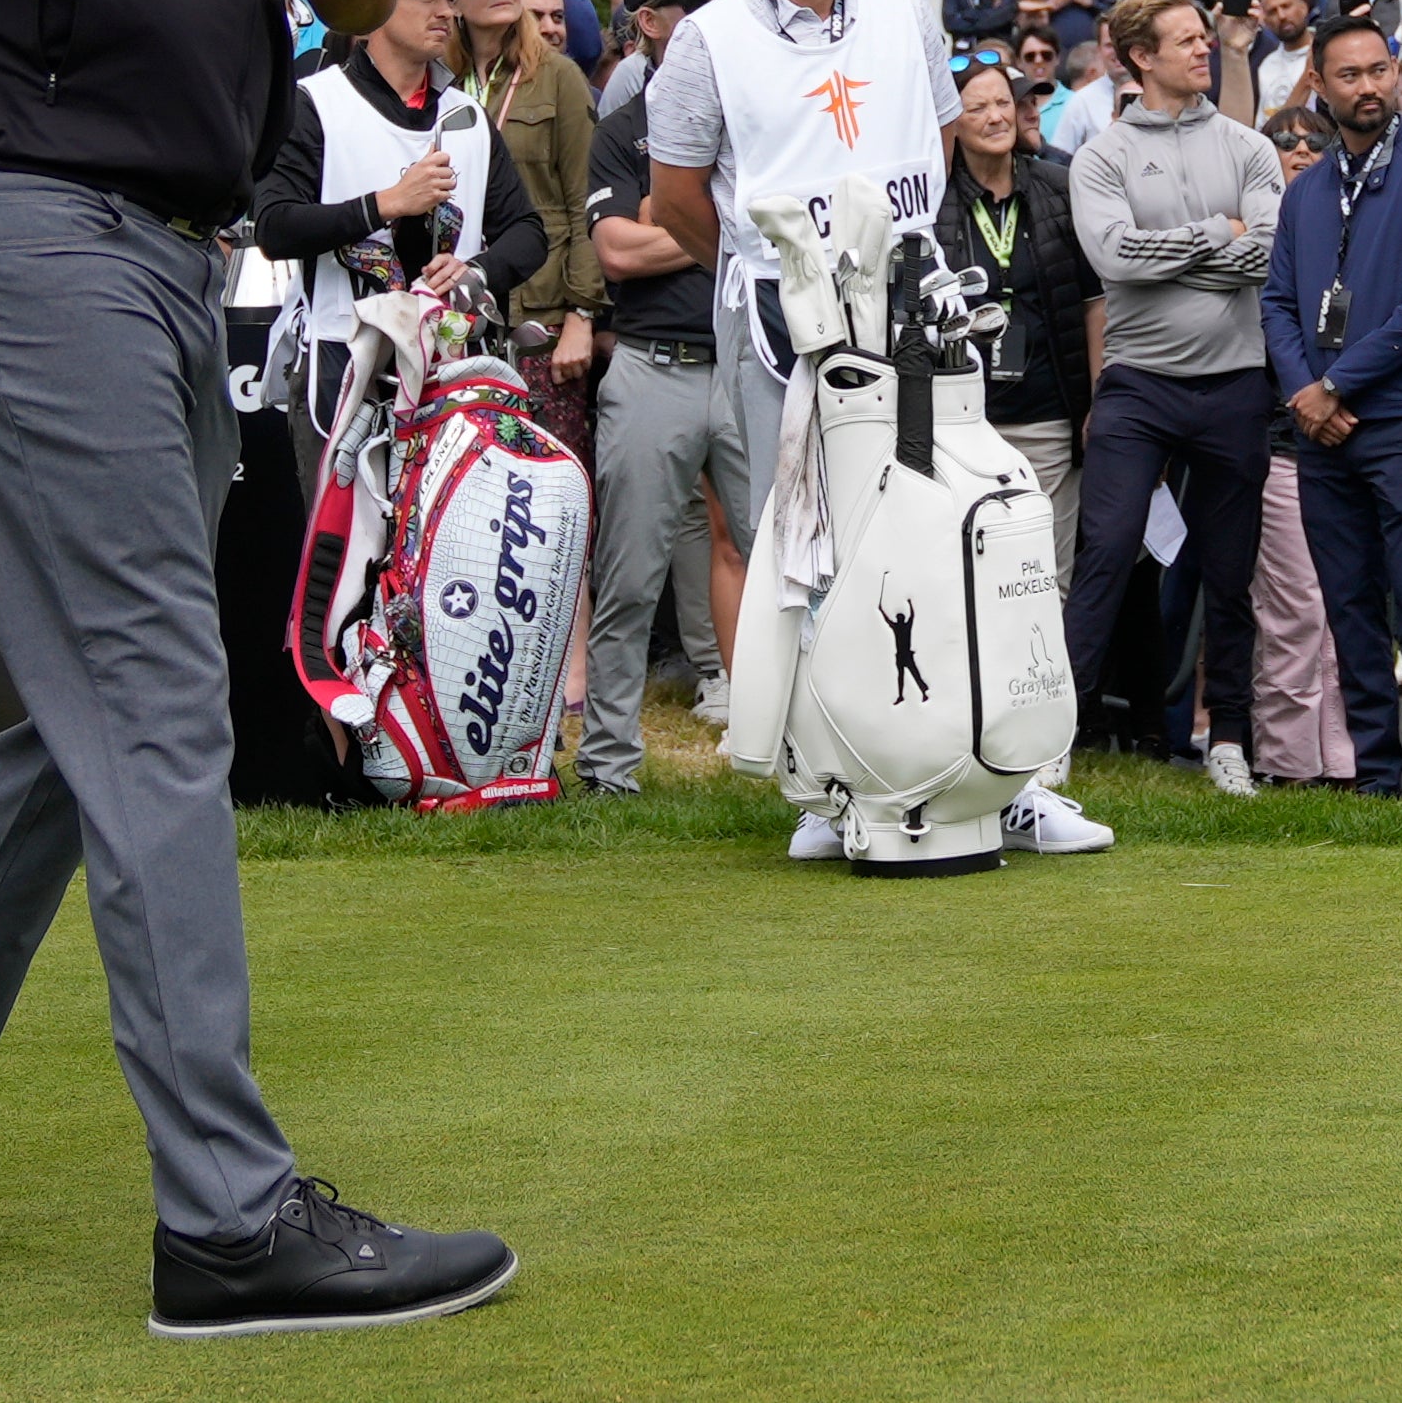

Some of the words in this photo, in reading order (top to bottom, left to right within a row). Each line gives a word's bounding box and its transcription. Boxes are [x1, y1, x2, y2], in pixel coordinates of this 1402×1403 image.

[549, 506, 570, 574] Technology
[1021, 558, 1045, 577] PHIL
[543, 578, 558, 608] Golf
[461, 611, 515, 756] elite
[490, 470, 546, 623] grips
[538, 609, 552, 630] for
[523, 632, 547, 697] Passion
[518, 699, 533, 724] The
[480, 782, 549, 799] elitegrips.com
